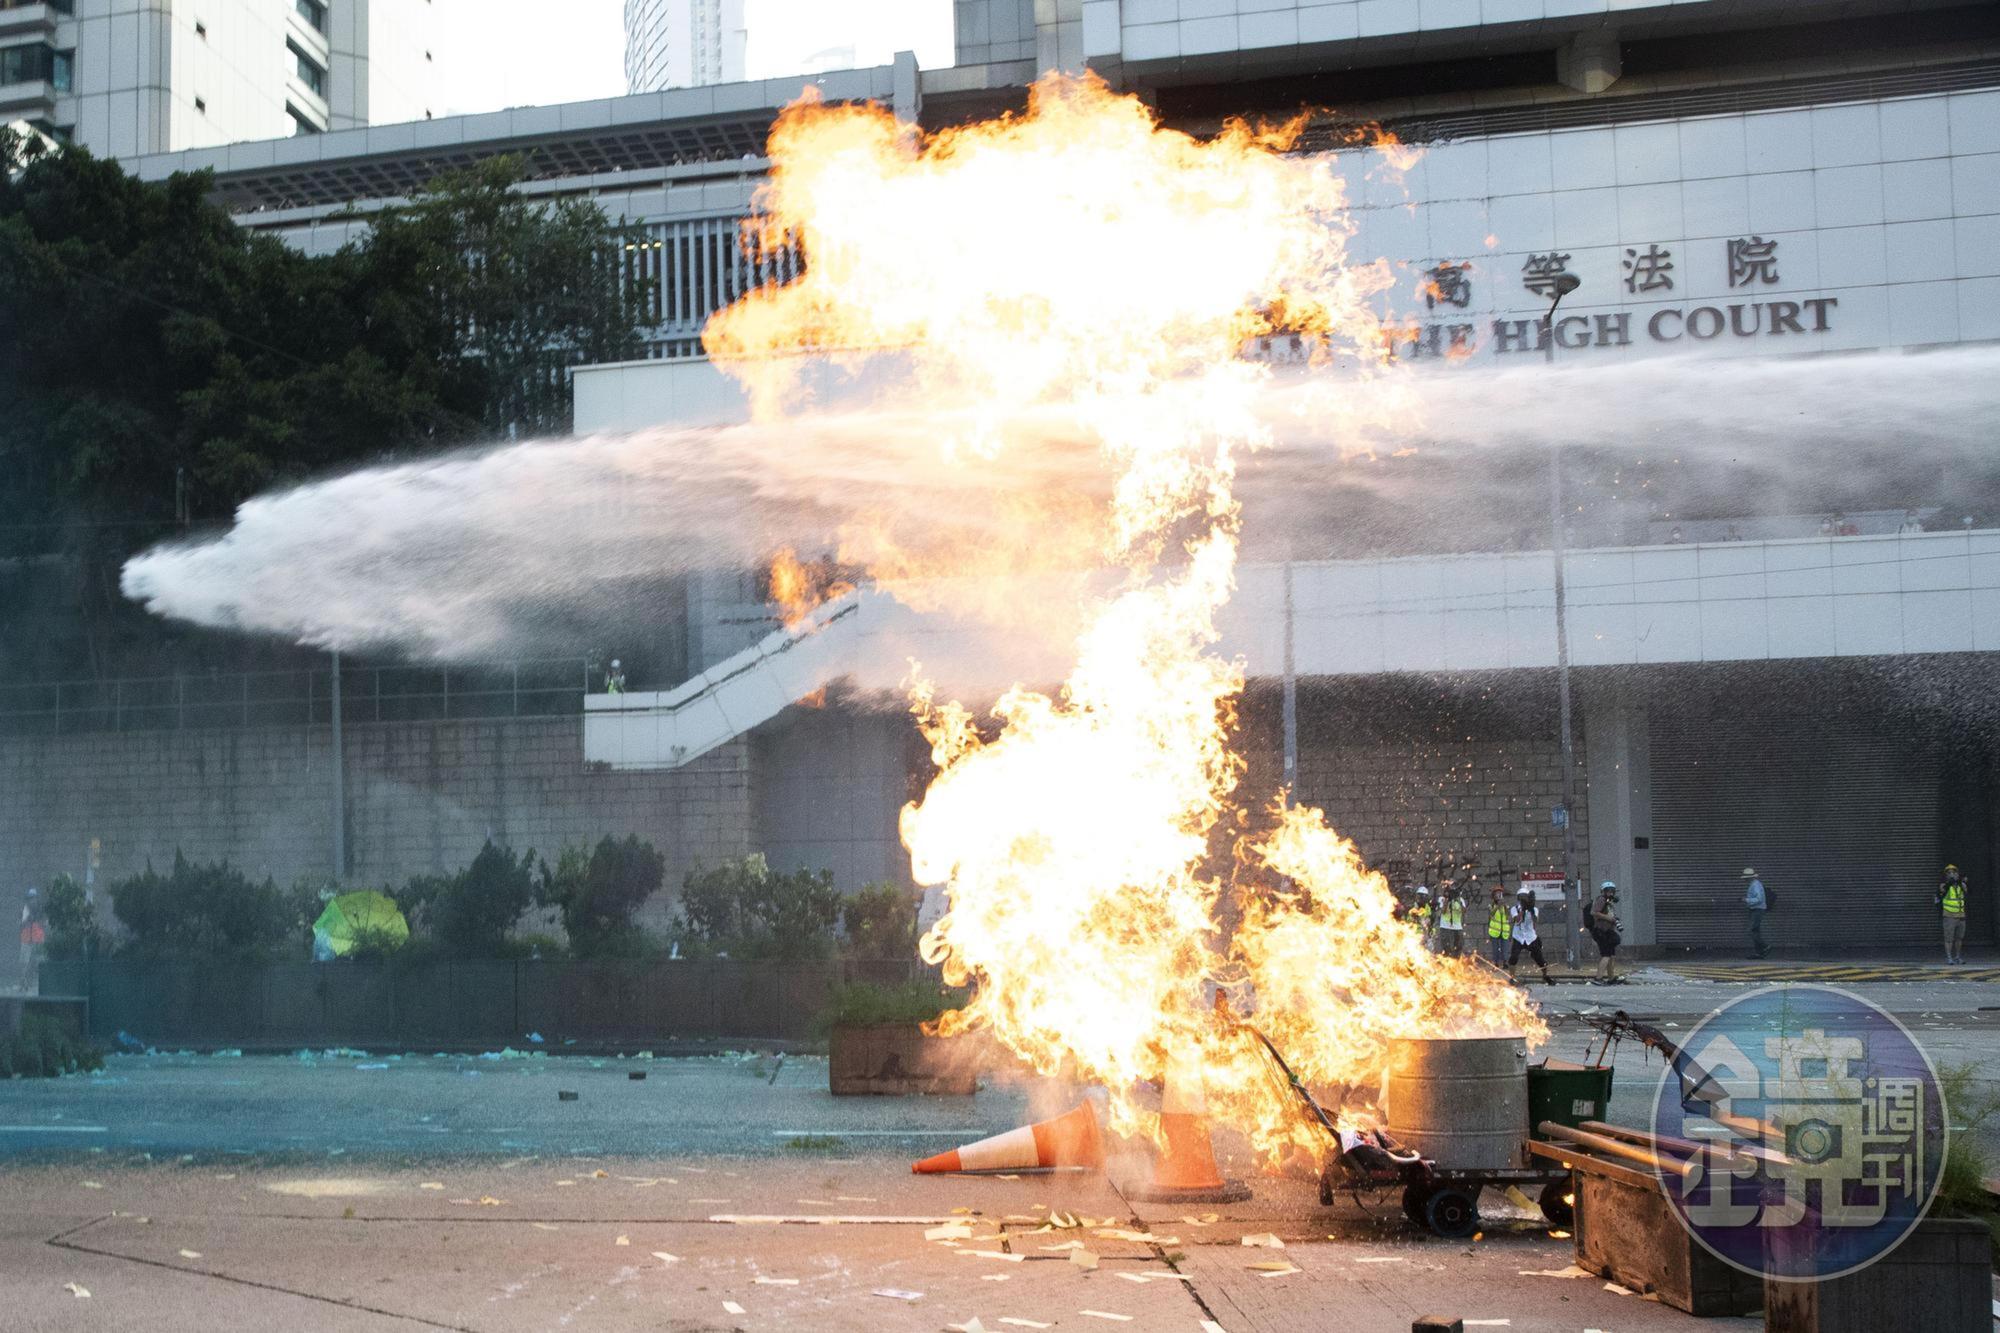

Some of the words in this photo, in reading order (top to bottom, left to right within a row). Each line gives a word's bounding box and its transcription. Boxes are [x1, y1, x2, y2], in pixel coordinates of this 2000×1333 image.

[1424, 236, 1780, 309] 高等法院
[1493, 311, 1632, 352] HIGH
[1648, 297, 1838, 343] COURT
